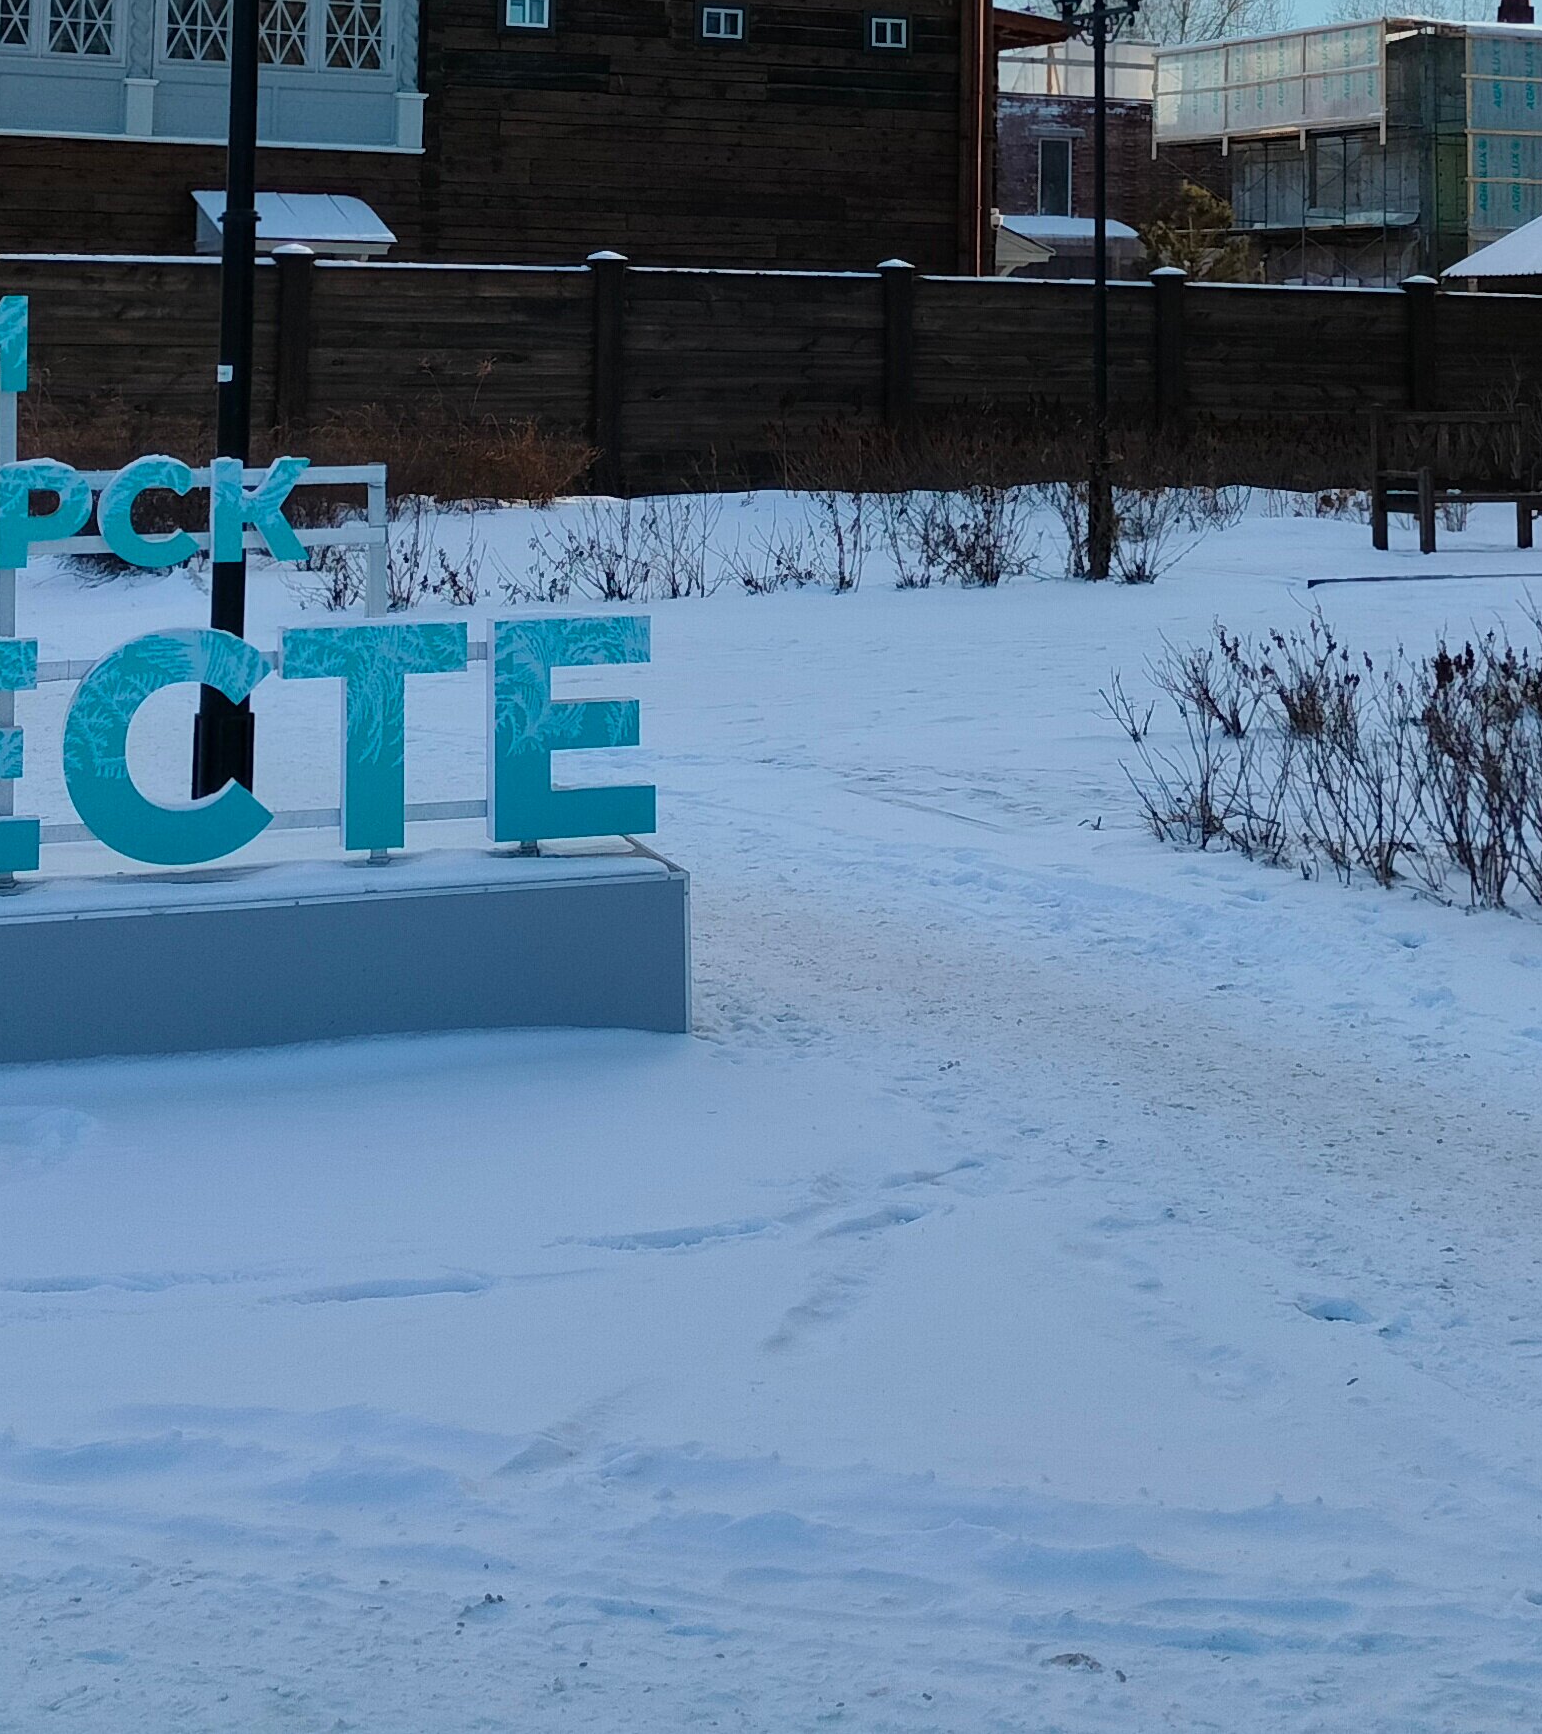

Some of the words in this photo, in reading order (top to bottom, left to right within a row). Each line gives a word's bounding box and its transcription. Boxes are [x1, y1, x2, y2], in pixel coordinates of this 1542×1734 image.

[1277, 51, 1285, 107] AGRLUX
[1492, 49, 1501, 109] AGRLUX
[1525, 51, 1534, 110] AGRLUX
[1512, 153, 1521, 213] AGRLUX
